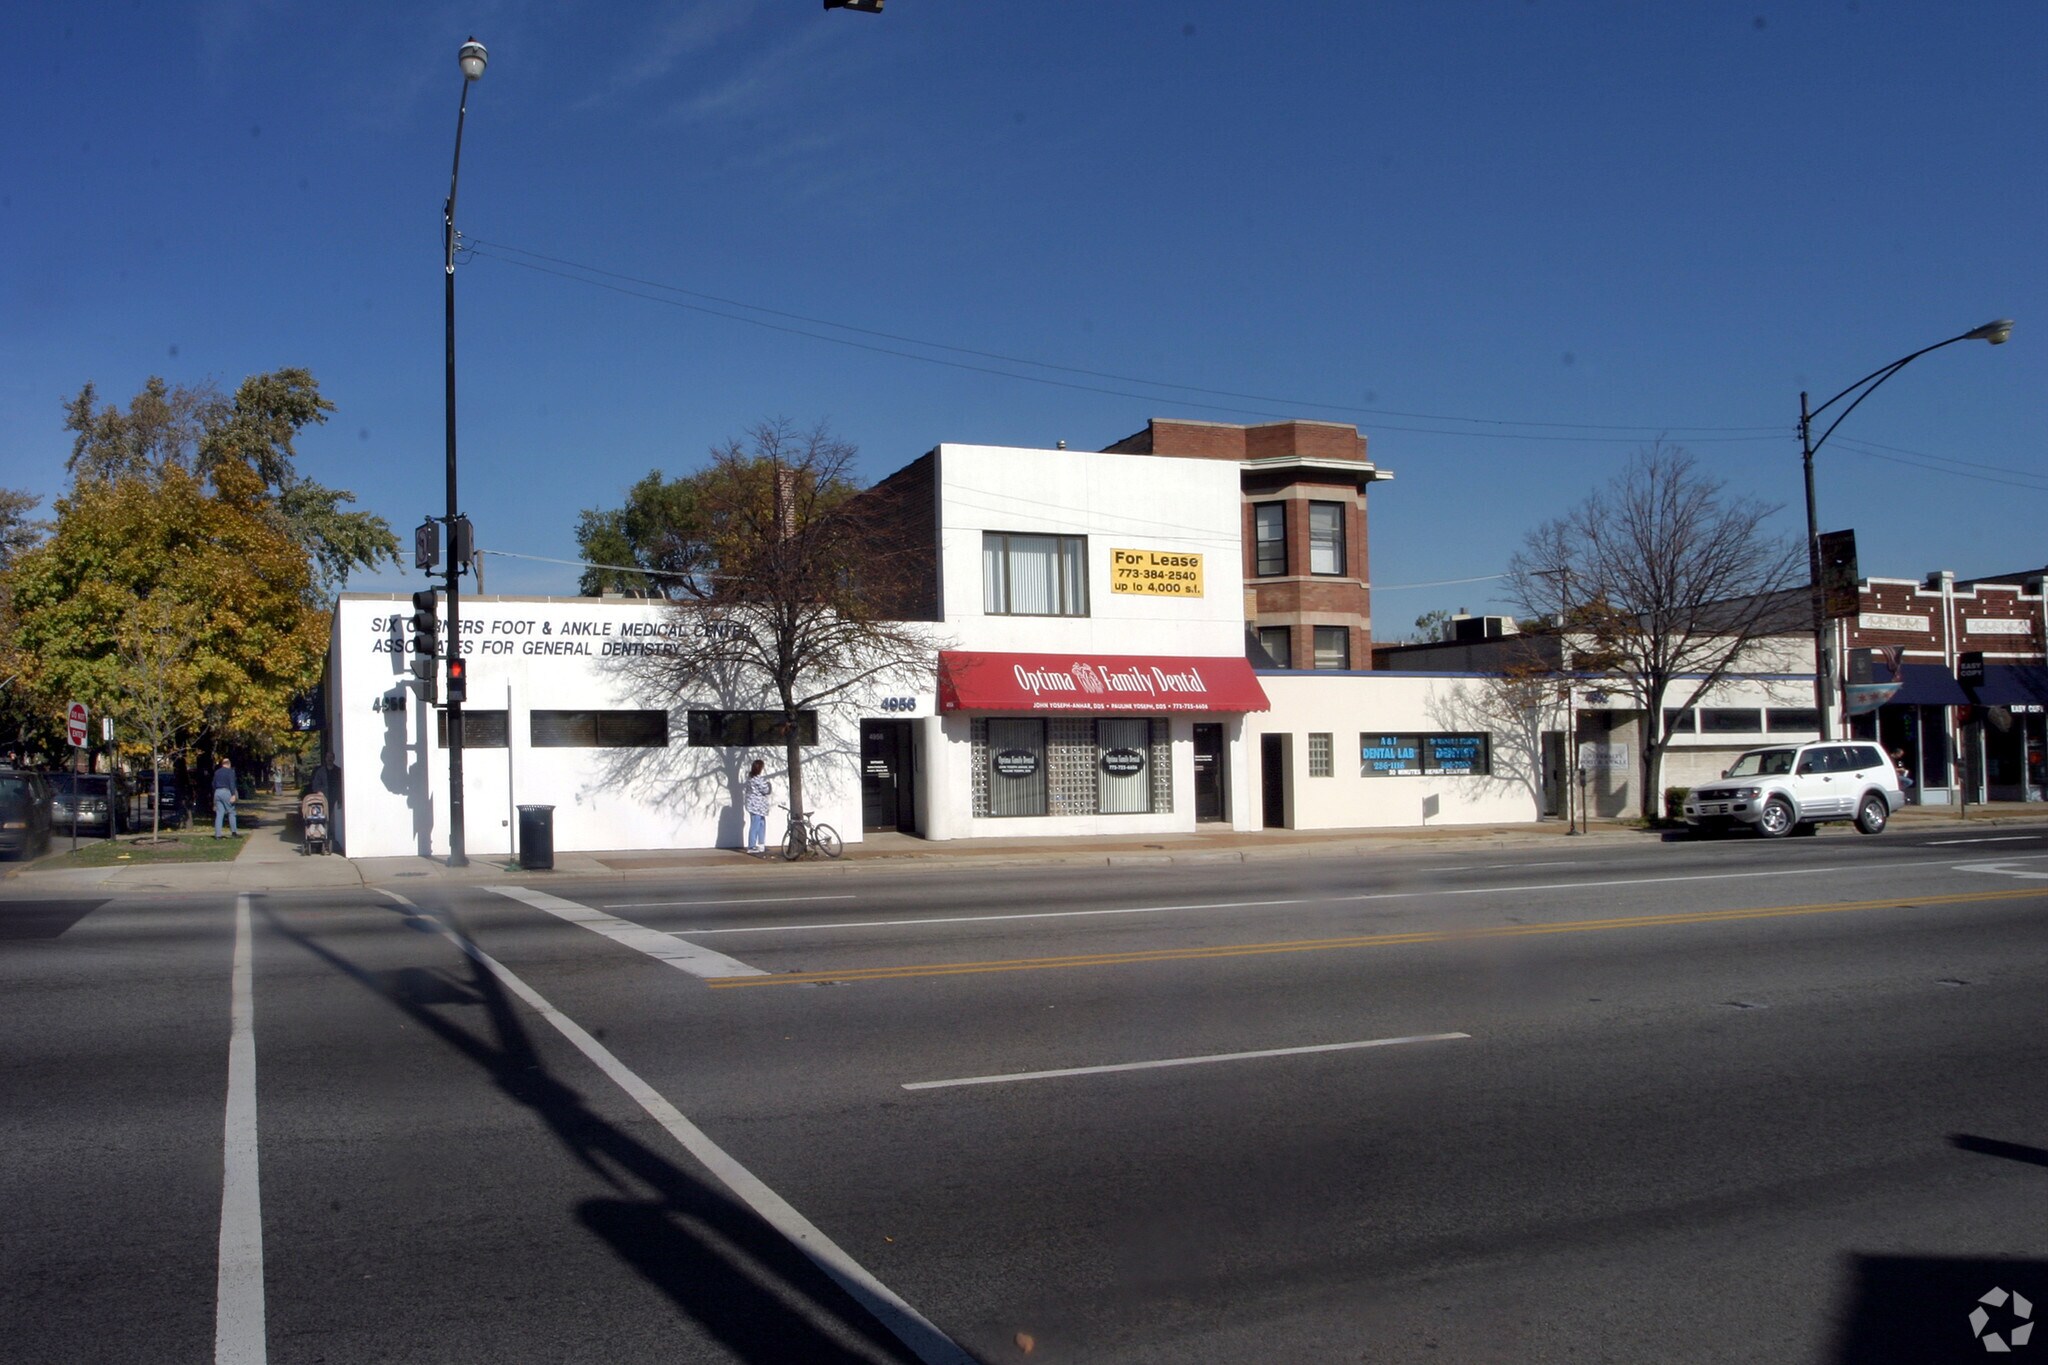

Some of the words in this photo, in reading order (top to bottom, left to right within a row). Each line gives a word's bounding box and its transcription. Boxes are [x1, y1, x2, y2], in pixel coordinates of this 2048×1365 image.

[1115, 552, 1143, 564] For
[1150, 553, 1198, 567] Lease
[1118, 568, 1196, 580] 773-384-2540
[1115, 583, 1128, 592] up
[1148, 583, 1181, 592] 4,000
[371, 618, 398, 632] SIX
[491, 620, 536, 634] FOOT
[542, 621, 552, 635] &
[560, 621, 612, 636] ANKLE
[620, 622, 688, 637] MEDICAL
[481, 640, 514, 654] FOR
[522, 641, 592, 655] GENERAL
[601, 642, 680, 656] DENTISTRY
[1014, 664, 1077, 696] Optima
[1098, 665, 1155, 697] Family
[1150, 666, 1207, 692] Dental
[2011, 704, 2026, 713] EASY
[73, 730, 83, 738] ENTER
[1363, 747, 1395, 759] DENTAL
[1398, 747, 1415, 759] LAB
